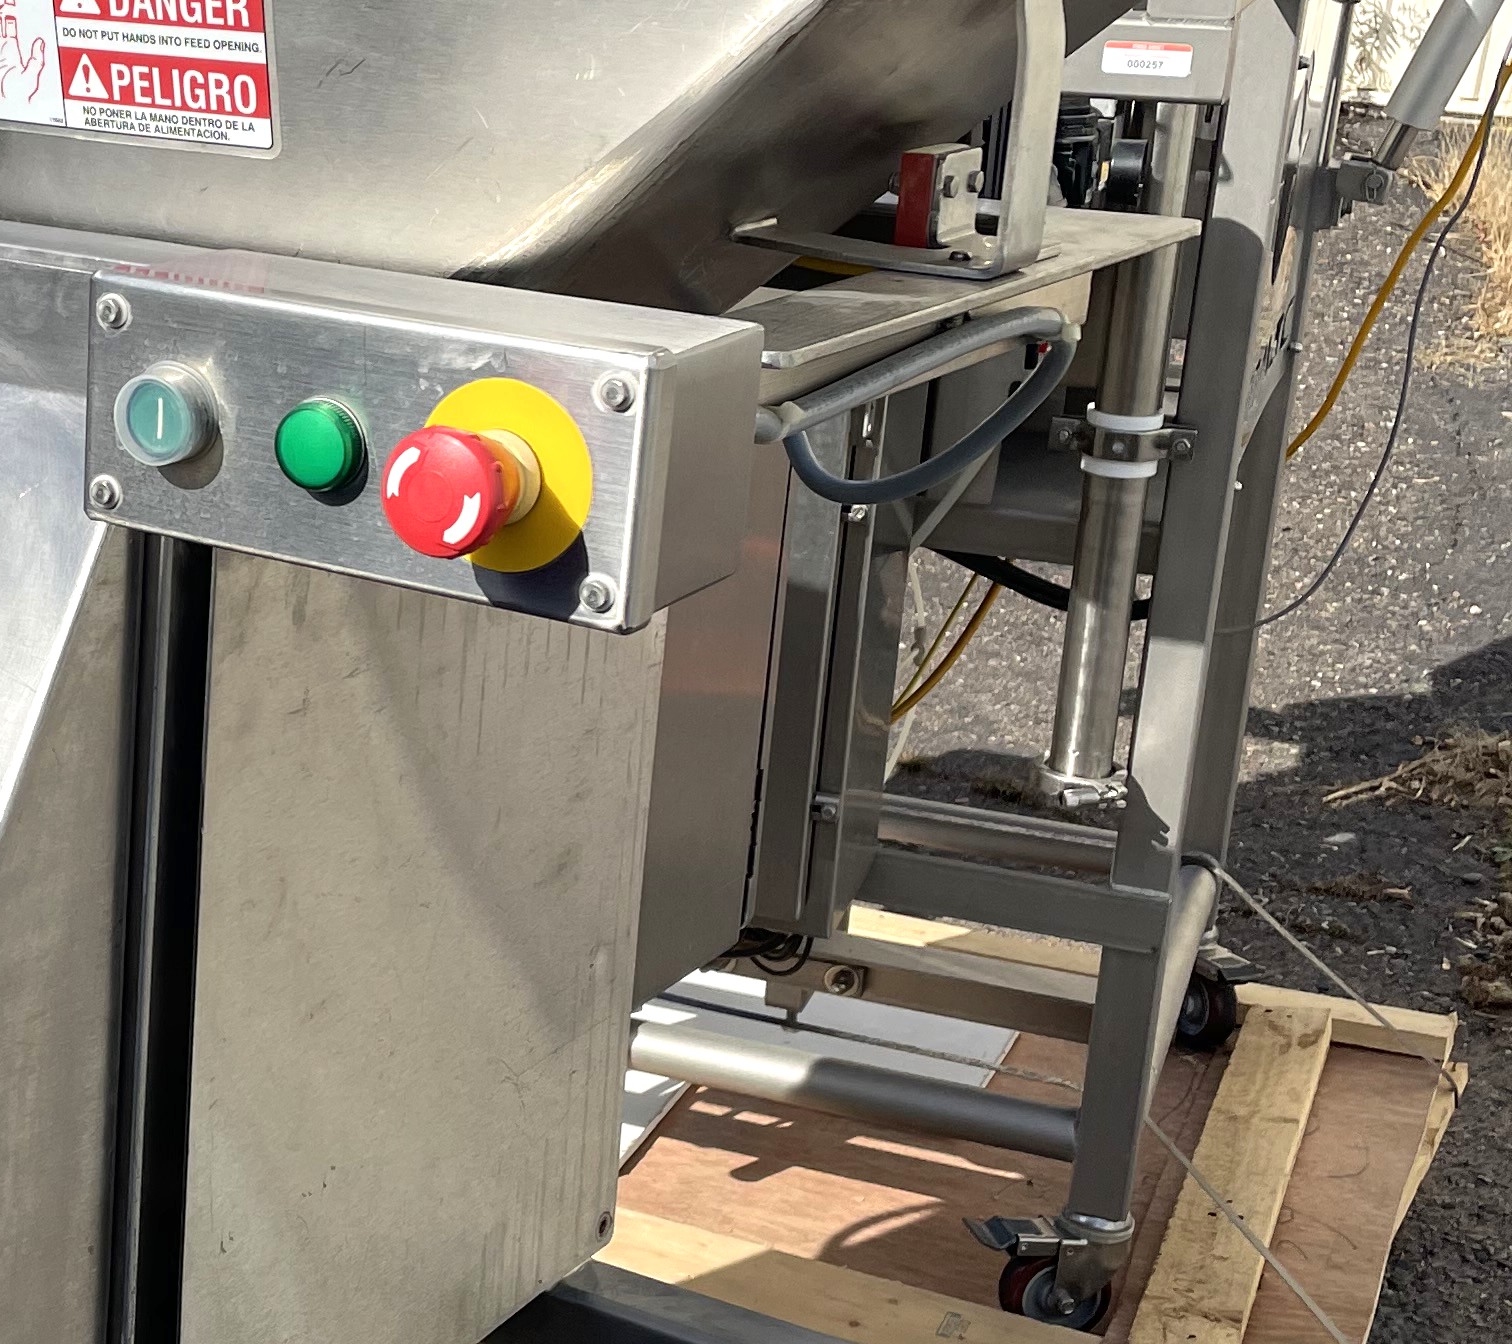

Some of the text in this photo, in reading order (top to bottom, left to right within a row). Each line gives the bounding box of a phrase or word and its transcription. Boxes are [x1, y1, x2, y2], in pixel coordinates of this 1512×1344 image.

[62, 27, 75, 37] DO
[79, 29, 98, 38] NOT
[101, 30, 118, 40] PUT
[122, 32, 155, 43] HANDS
[159, 35, 181, 45] INTO
[185, 37, 209, 48] FEED
[1127, 59, 1164, 70] 000257
[109, 62, 257, 116] PELIGRO
[83, 106, 254, 131] NO PONER LA MANO DENTRO DE LA
[84, 117, 134, 130] ABERTURA
[138, 123, 150, 131] DE
